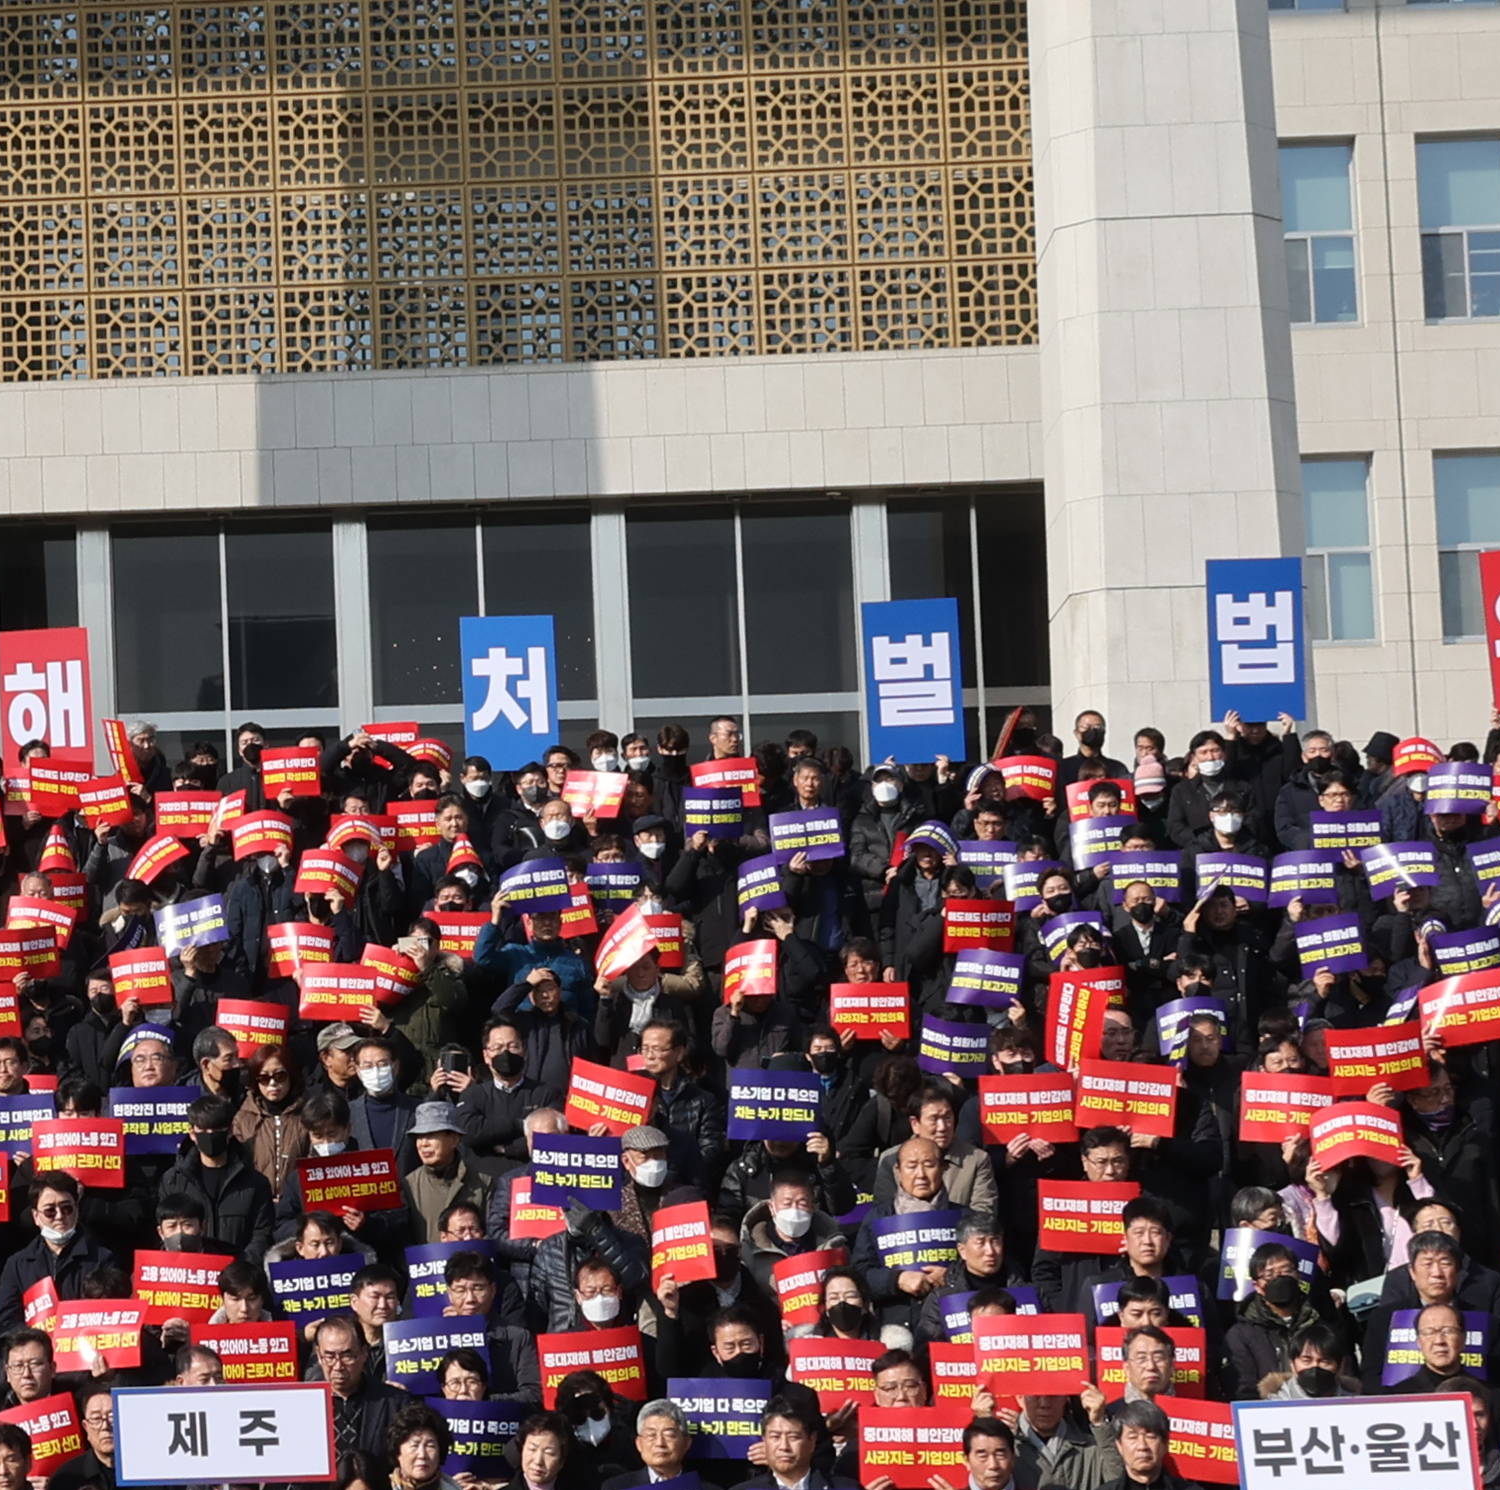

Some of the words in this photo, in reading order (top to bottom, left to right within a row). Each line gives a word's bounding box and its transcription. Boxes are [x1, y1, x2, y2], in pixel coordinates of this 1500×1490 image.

[1216, 591, 1295, 684] 법
[872, 632, 954, 726] 벌
[472, 647, 549, 734] 처
[3, 660, 88, 748] 해
[731, 1086, 771, 1100] 중소기업
[774, 1088, 786, 1100] 다
[788, 1088, 818, 1102] 죽으면
[1082, 1076, 1125, 1092] 중대재해
[1128, 1081, 1171, 1097] 불안감에
[984, 1092, 1027, 1105] 중대재해
[1029, 1090, 1071, 1104] 불안감에
[1080, 1096, 1123, 1111] 사라지는
[1127, 1101, 1170, 1116] 기업의욕
[735, 1106, 755, 1119] 차는
[758, 1107, 780, 1120] 누가
[782, 1108, 814, 1121] 만드나
[986, 1112, 1028, 1124] 사라지는
[1031, 1109, 1072, 1123] 기업의욕
[979, 1335, 1029, 1351] 중대재해
[1032, 1334, 1081, 1349] 불안감에
[981, 1358, 1030, 1372] 사라지는
[1034, 1356, 1083, 1371] 기업의욕
[1253, 1422, 1460, 1477] 부산·울산
